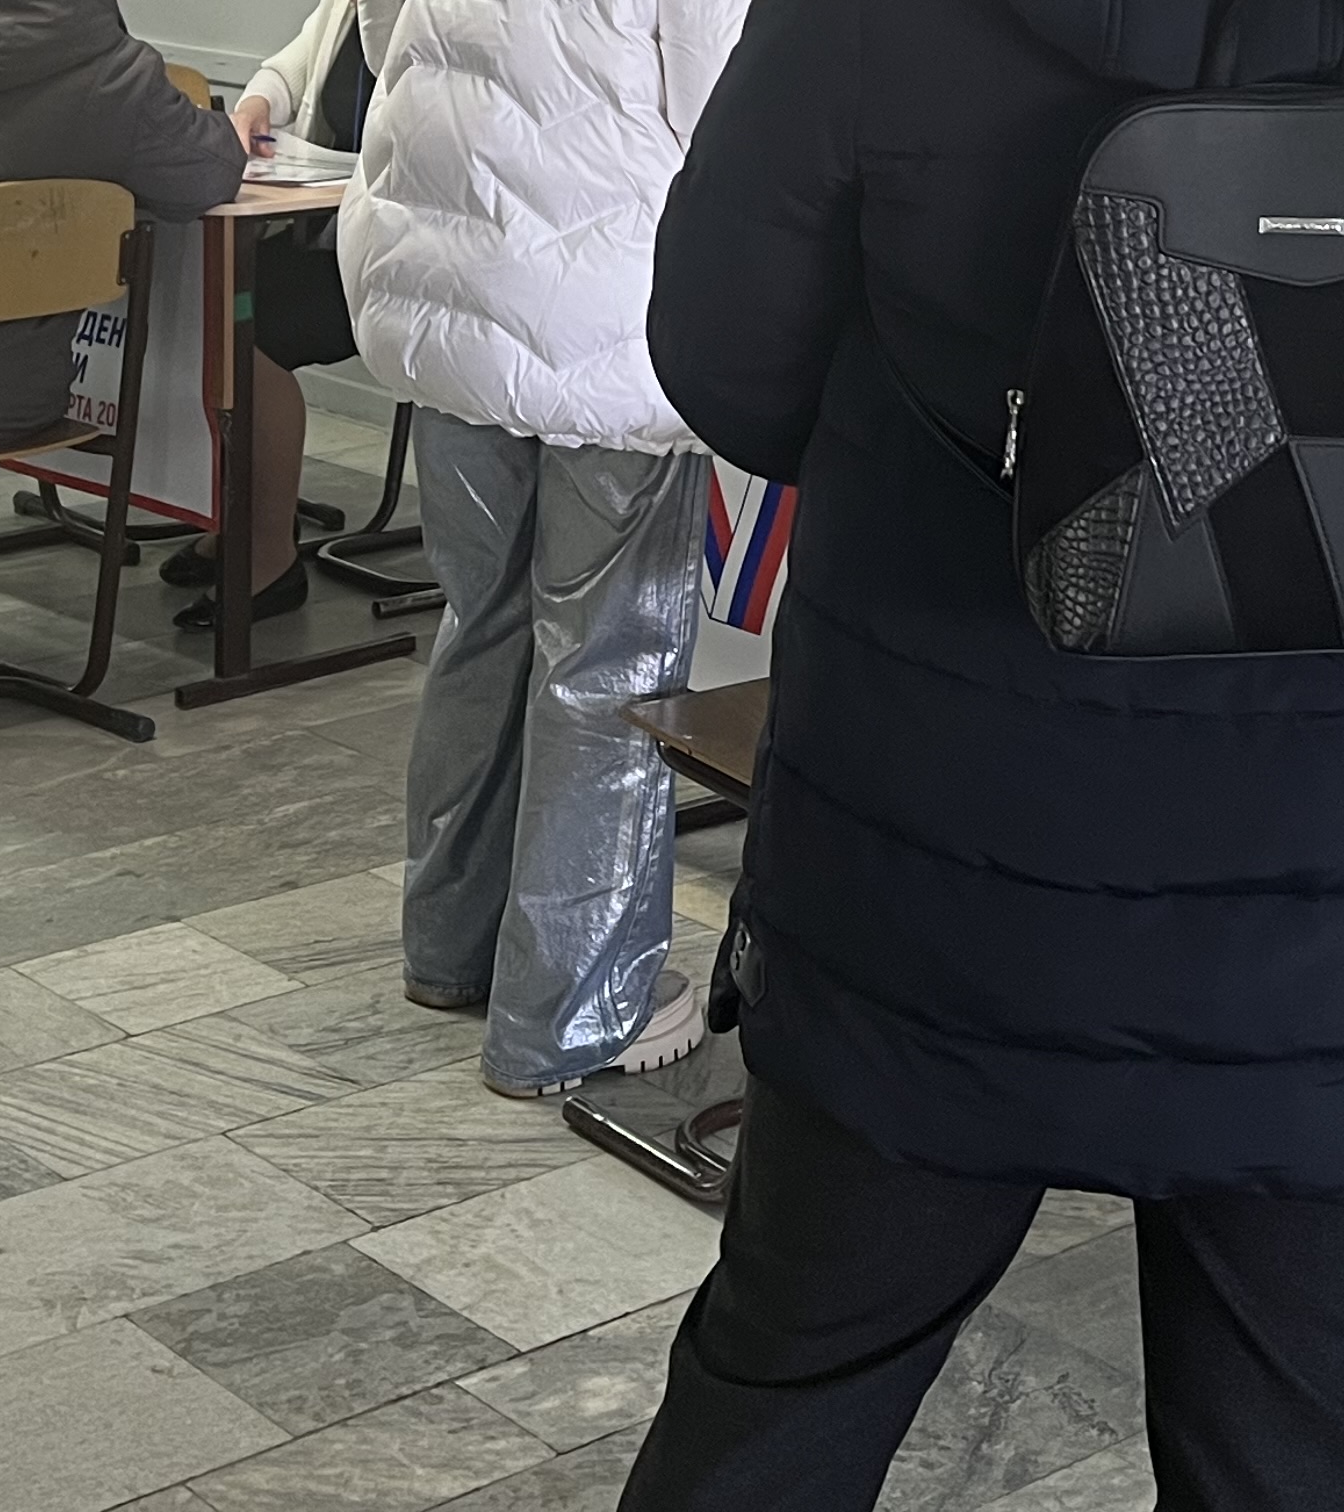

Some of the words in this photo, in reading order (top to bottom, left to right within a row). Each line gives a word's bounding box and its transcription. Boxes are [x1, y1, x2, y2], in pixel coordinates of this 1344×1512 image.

[76, 310, 127, 348] ДЕН
[67, 393, 92, 422] РТА
[97, 400, 117, 427] 20
